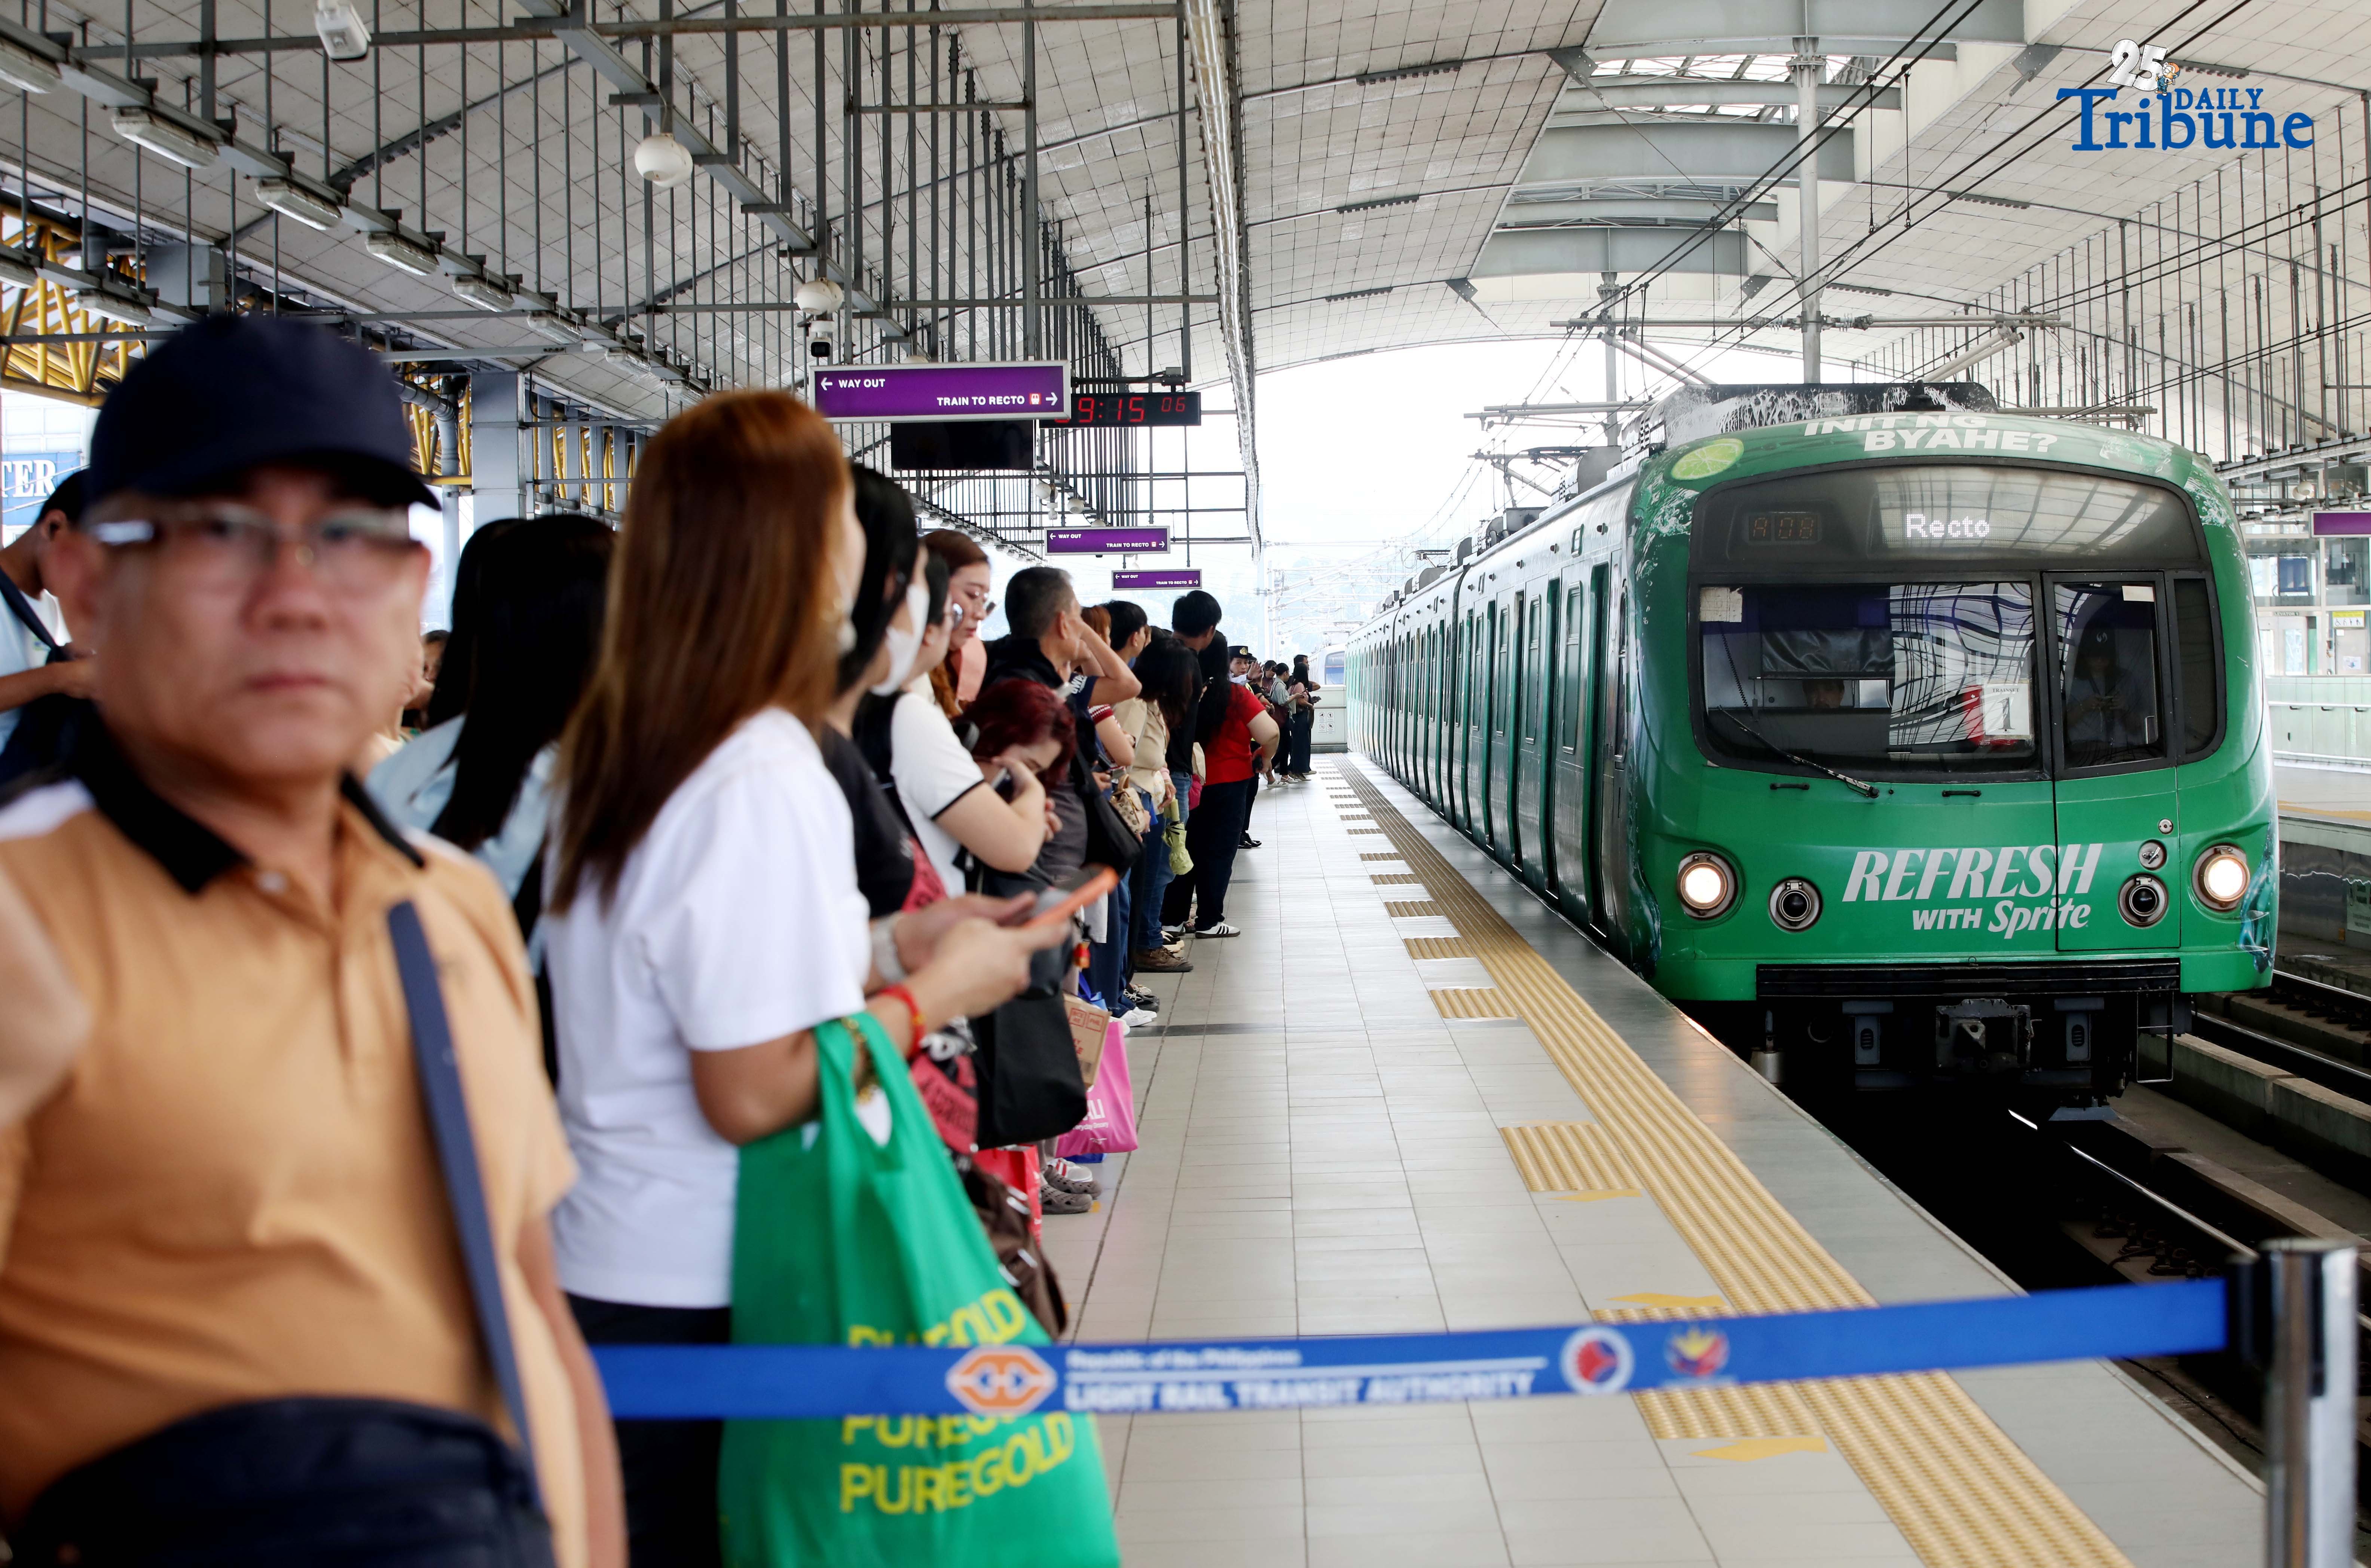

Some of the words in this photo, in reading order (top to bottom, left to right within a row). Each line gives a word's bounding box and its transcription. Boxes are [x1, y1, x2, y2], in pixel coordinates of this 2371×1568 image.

[838, 379, 861, 388] WAY
[864, 378, 886, 388] OUT
[937, 396, 969, 406] TRAIN
[971, 396, 987, 406] TO
[989, 395, 1025, 405] RECTO
[1054, 397, 1145, 423] 9:15
[1161, 397, 1186, 412] 06
[1803, 415, 1907, 437] INIT
[1914, 415, 1987, 428] NG
[1863, 429, 2058, 453] BYAHE?
[1906, 513, 1990, 538] Recto
[1997, 697, 2016, 730] 1
[1842, 843, 2103, 902] REFRESH
[1912, 908, 1982, 930] WITH
[1987, 898, 2091, 939] Sprite
[1083, 1098, 1106, 1121] ALI
[1064, 1382, 1154, 1411] LIGHT
[1160, 1381, 1232, 1410] RAIL
[1232, 1377, 1363, 1408] TRANSIT
[1365, 1371, 1536, 1404] AUTHORITY
[840, 1410, 1075, 1515] PUREGOLD
